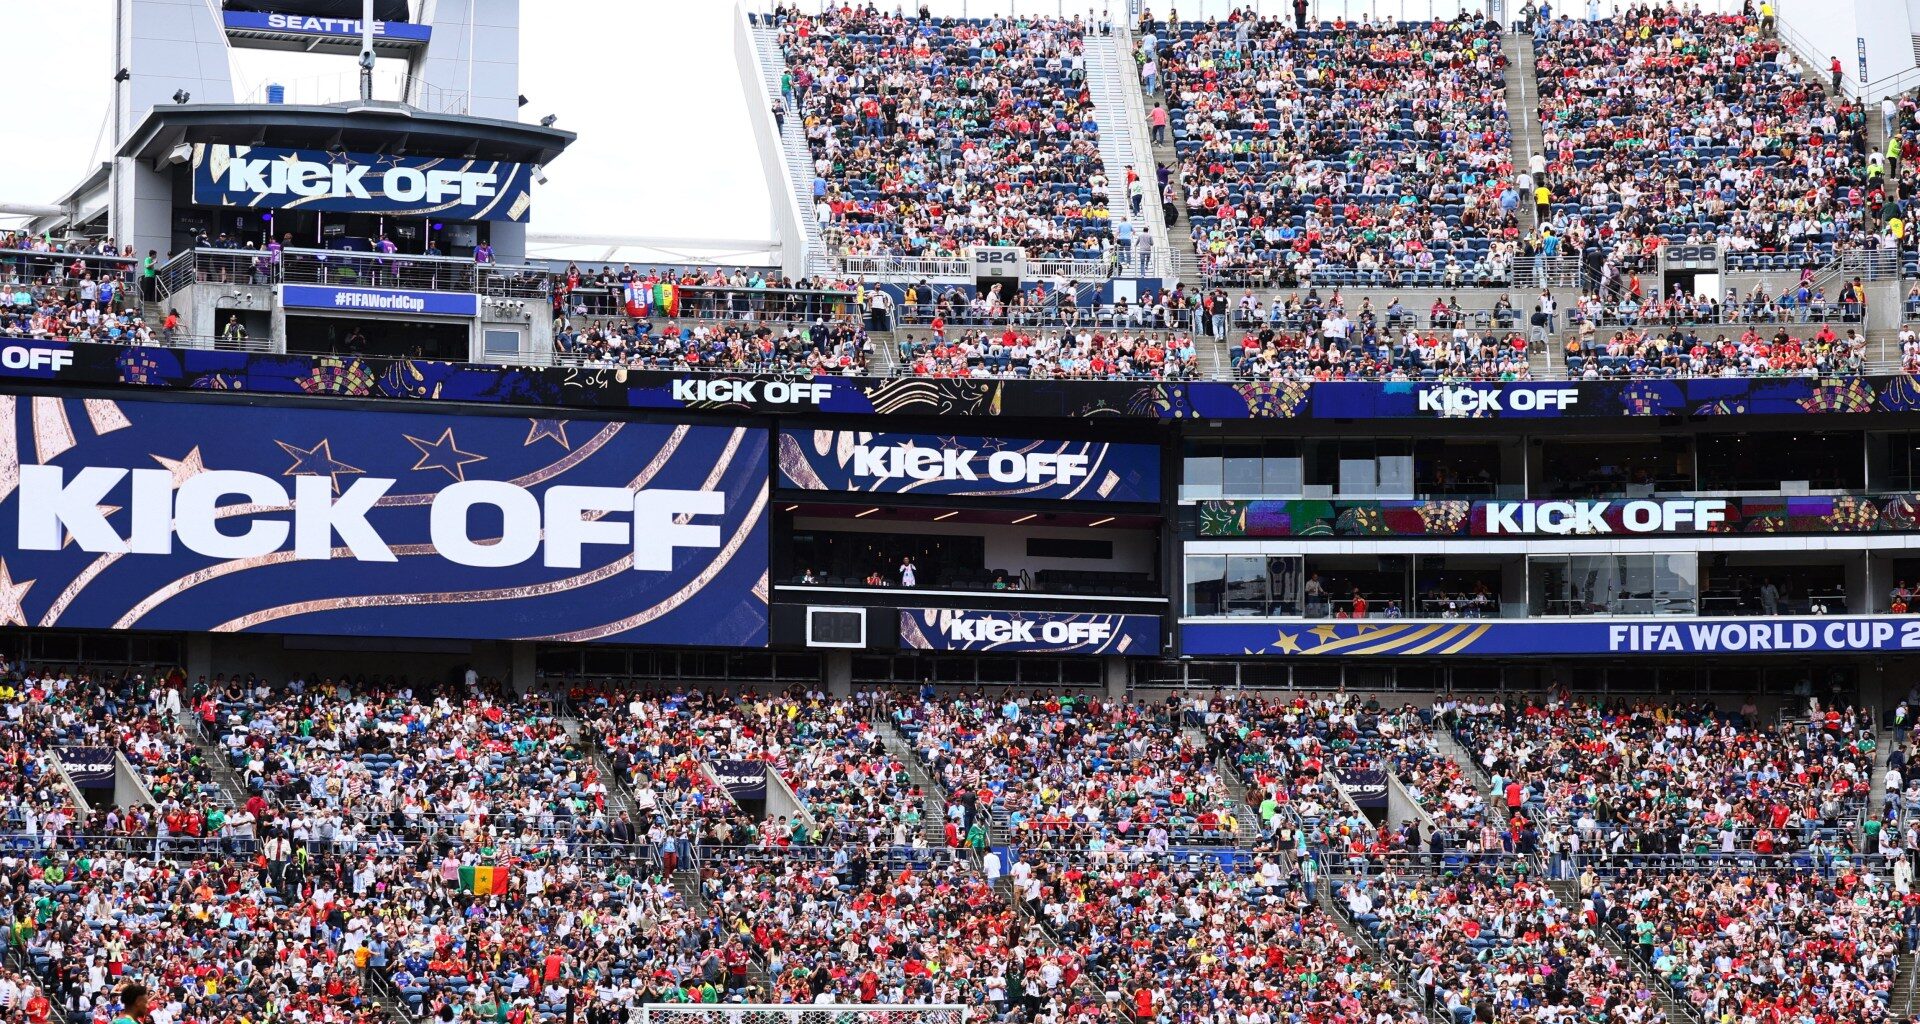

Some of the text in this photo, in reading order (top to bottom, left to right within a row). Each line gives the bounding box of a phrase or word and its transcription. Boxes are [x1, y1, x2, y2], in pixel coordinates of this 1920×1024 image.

[269, 14, 385, 35] SEATTLE
[229, 158, 498, 206] KICK OFF
[976, 251, 1017, 263] 324
[1666, 246, 1716, 261] 326
[335, 292, 425, 313] #FIFAWorldCup
[2, 346, 74, 371] OFF
[673, 379, 832, 404] KICK OFF
[1418, 387, 1579, 412] KICK OFF
[853, 445, 1088, 485] KICK OFF
[18, 463, 725, 572] KICK OFF
[1486, 499, 1727, 534] KICK OFF
[950, 618, 1111, 645] KICK OFF
[1609, 625, 1684, 651] FIFA
[1689, 624, 1817, 651] WORLD
[1824, 622, 1894, 649] CUP
[87, 763, 112, 772] OFF
[740, 775, 764, 784] OFF
[1362, 784, 1386, 792] OFF
